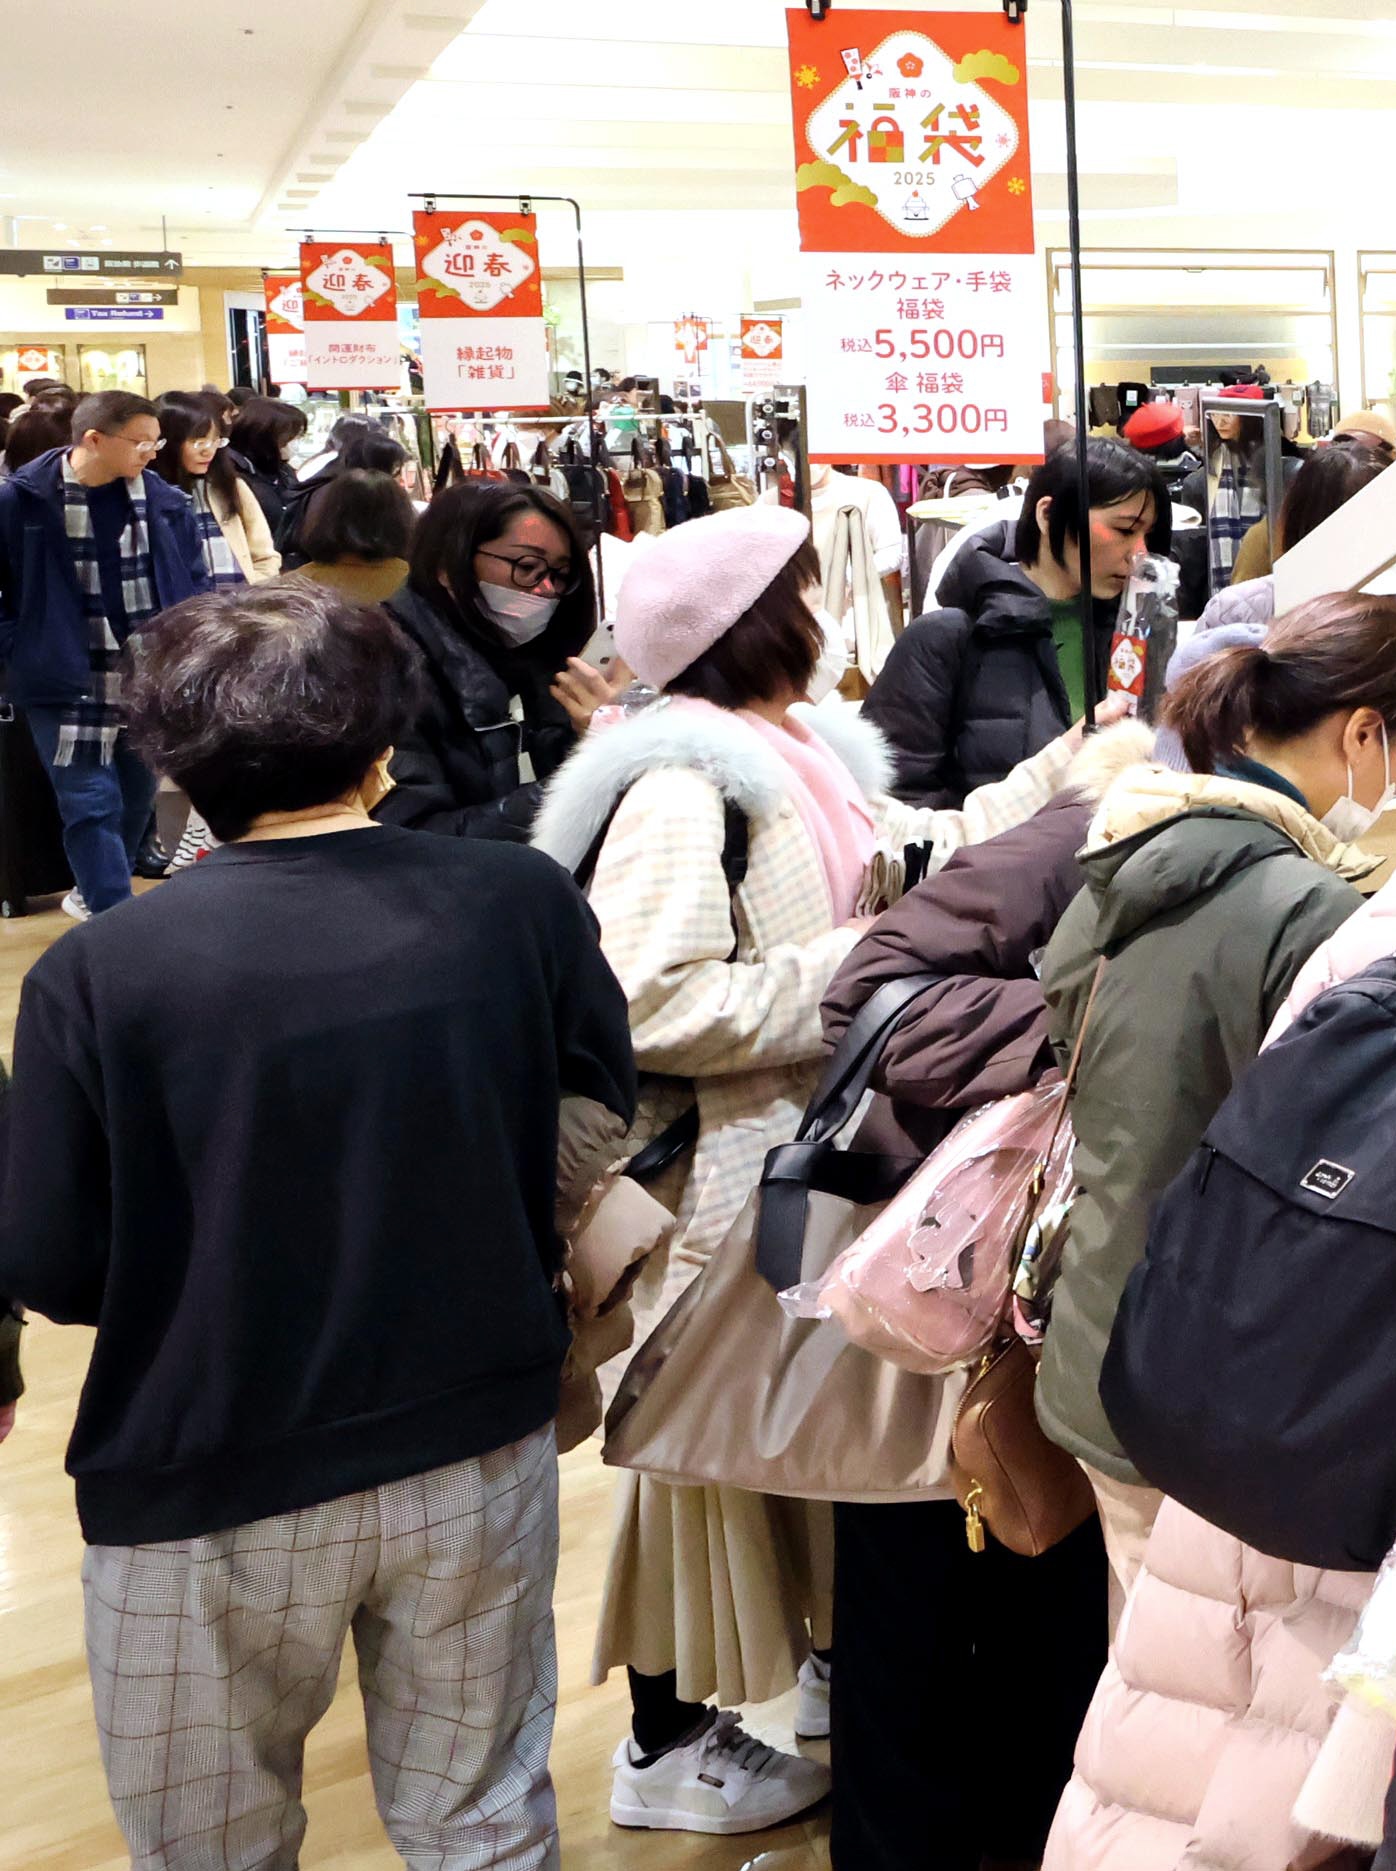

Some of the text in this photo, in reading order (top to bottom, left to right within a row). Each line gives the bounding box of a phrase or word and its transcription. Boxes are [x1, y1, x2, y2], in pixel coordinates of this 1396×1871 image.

[888, 87, 931, 99] 阪神の
[826, 102, 985, 167] 福袋
[893, 171, 936, 186] 2025
[444, 252, 512, 277] 迎春
[322, 273, 374, 292] 迎春
[824, 270, 1012, 293] ネックウェア・手袋
[896, 298, 945, 320] 福袋
[456, 346, 513, 361] 縁起物
[840, 328, 1004, 361] 税込5,500円
[457, 364, 515, 380] 「雑貨」
[884, 371, 964, 394] 傘 福袋
[843, 403, 1008, 436] 税込3,300円
